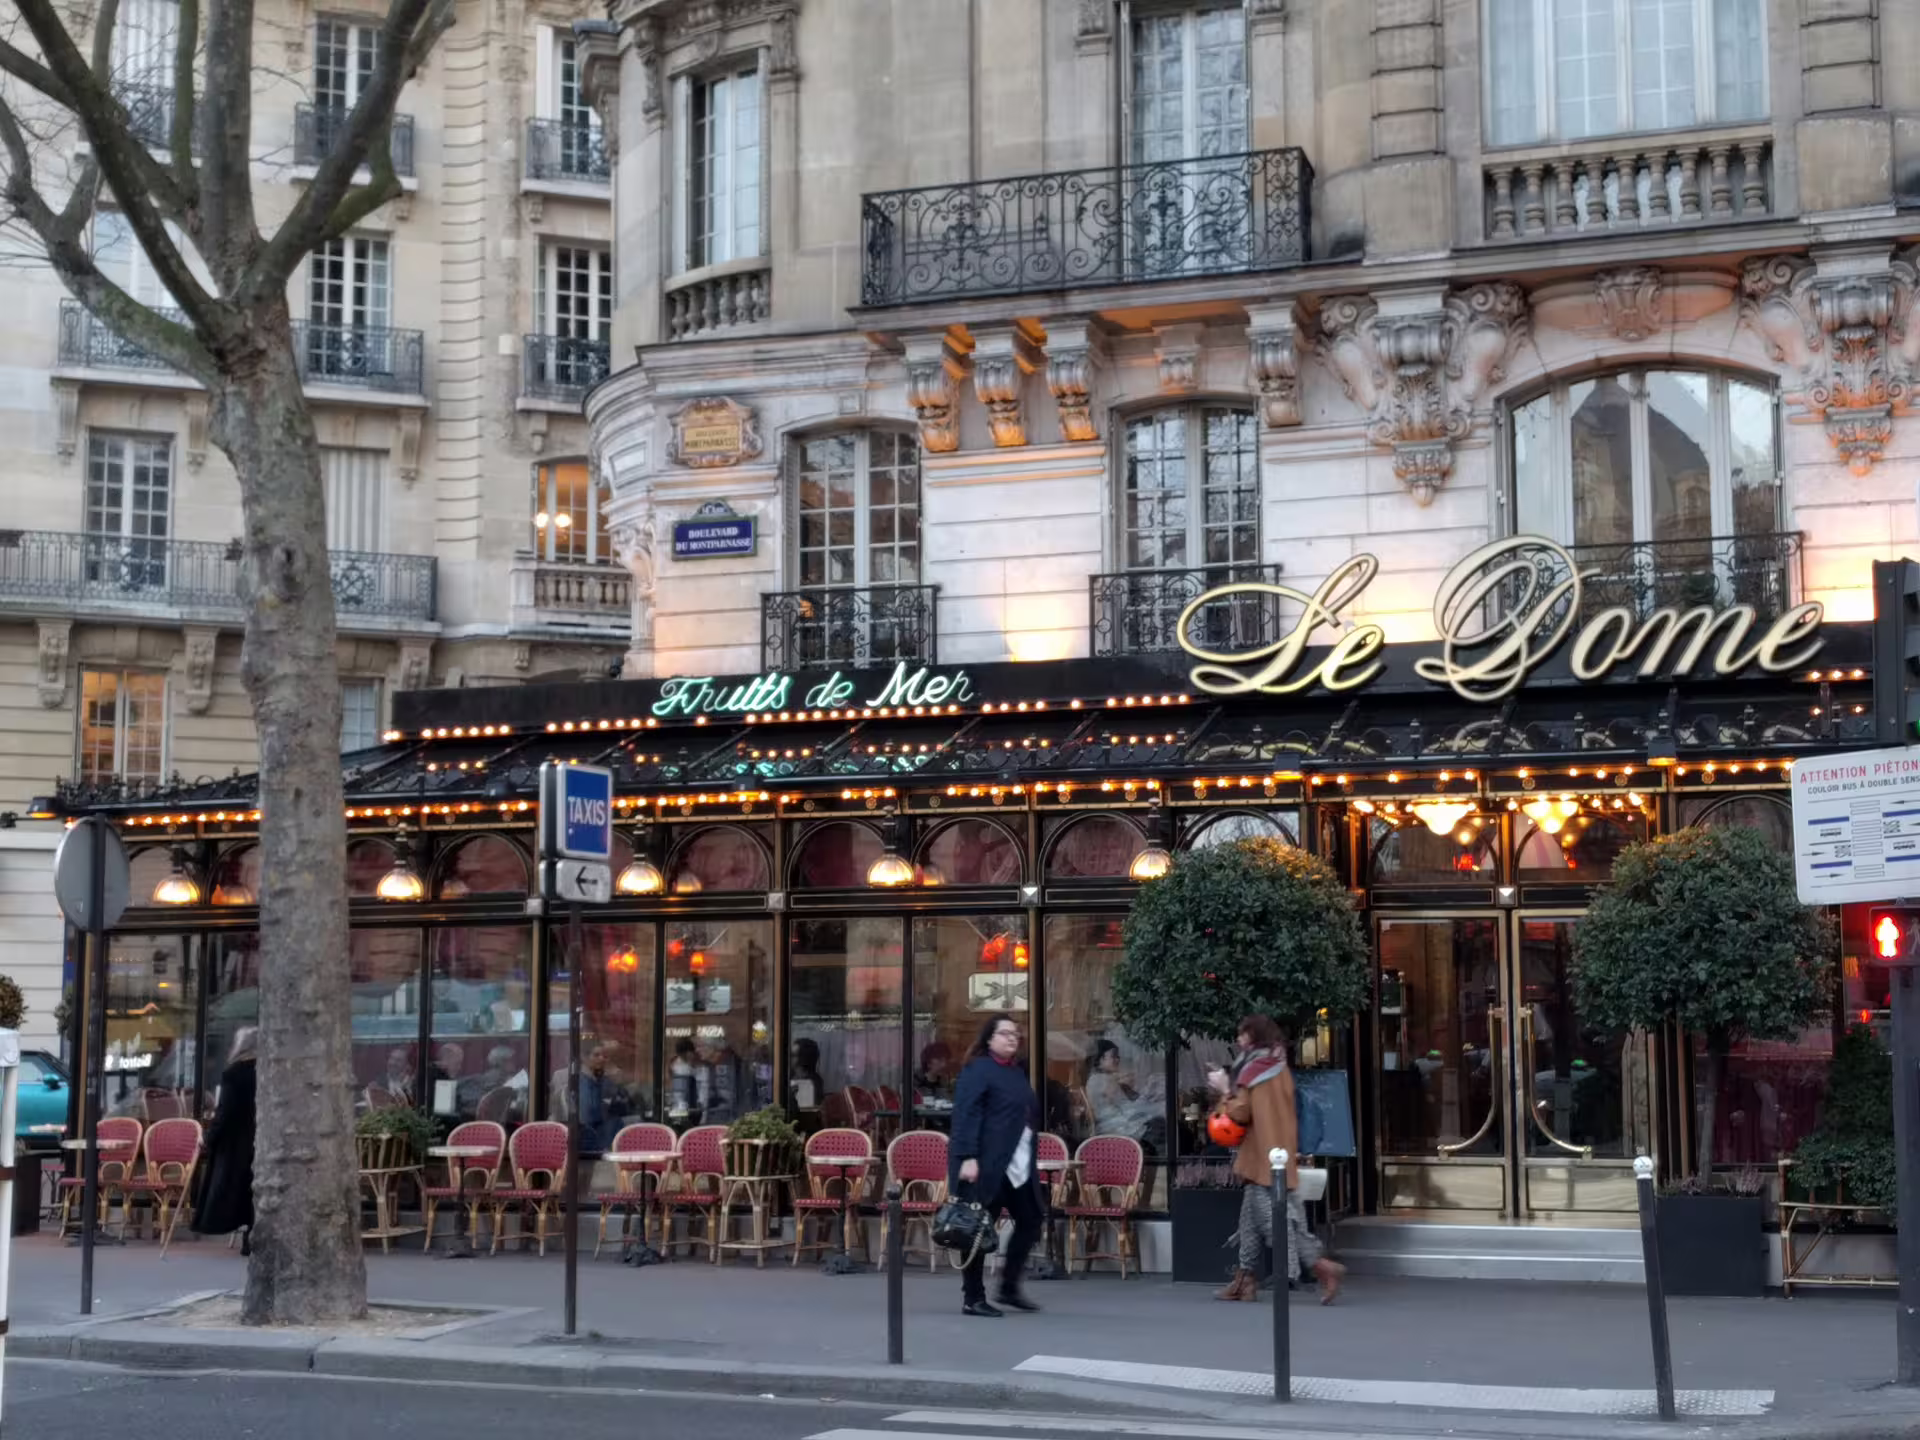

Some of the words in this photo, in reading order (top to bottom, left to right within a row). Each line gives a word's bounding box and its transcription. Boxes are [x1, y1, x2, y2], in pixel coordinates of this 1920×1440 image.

[676, 541, 688, 551] DU
[689, 538, 751, 550] MONTPARNASSE
[688, 527, 738, 539] BOULEVARD
[1176, 553, 1386, 694] Le
[1415, 533, 1827, 703] Dome
[651, 671, 792, 715] Fruits
[805, 670, 855, 708] de
[865, 660, 976, 707] Mer
[1800, 765, 1867, 784] ATTENTION
[1874, 759, 1920, 776] PIÉTON
[1808, 784, 1839, 794] COULOIR
[1842, 782, 1858, 791] BUS
[1868, 777, 1898, 788] DOUBLE
[568, 796, 605, 825] TAXIS
